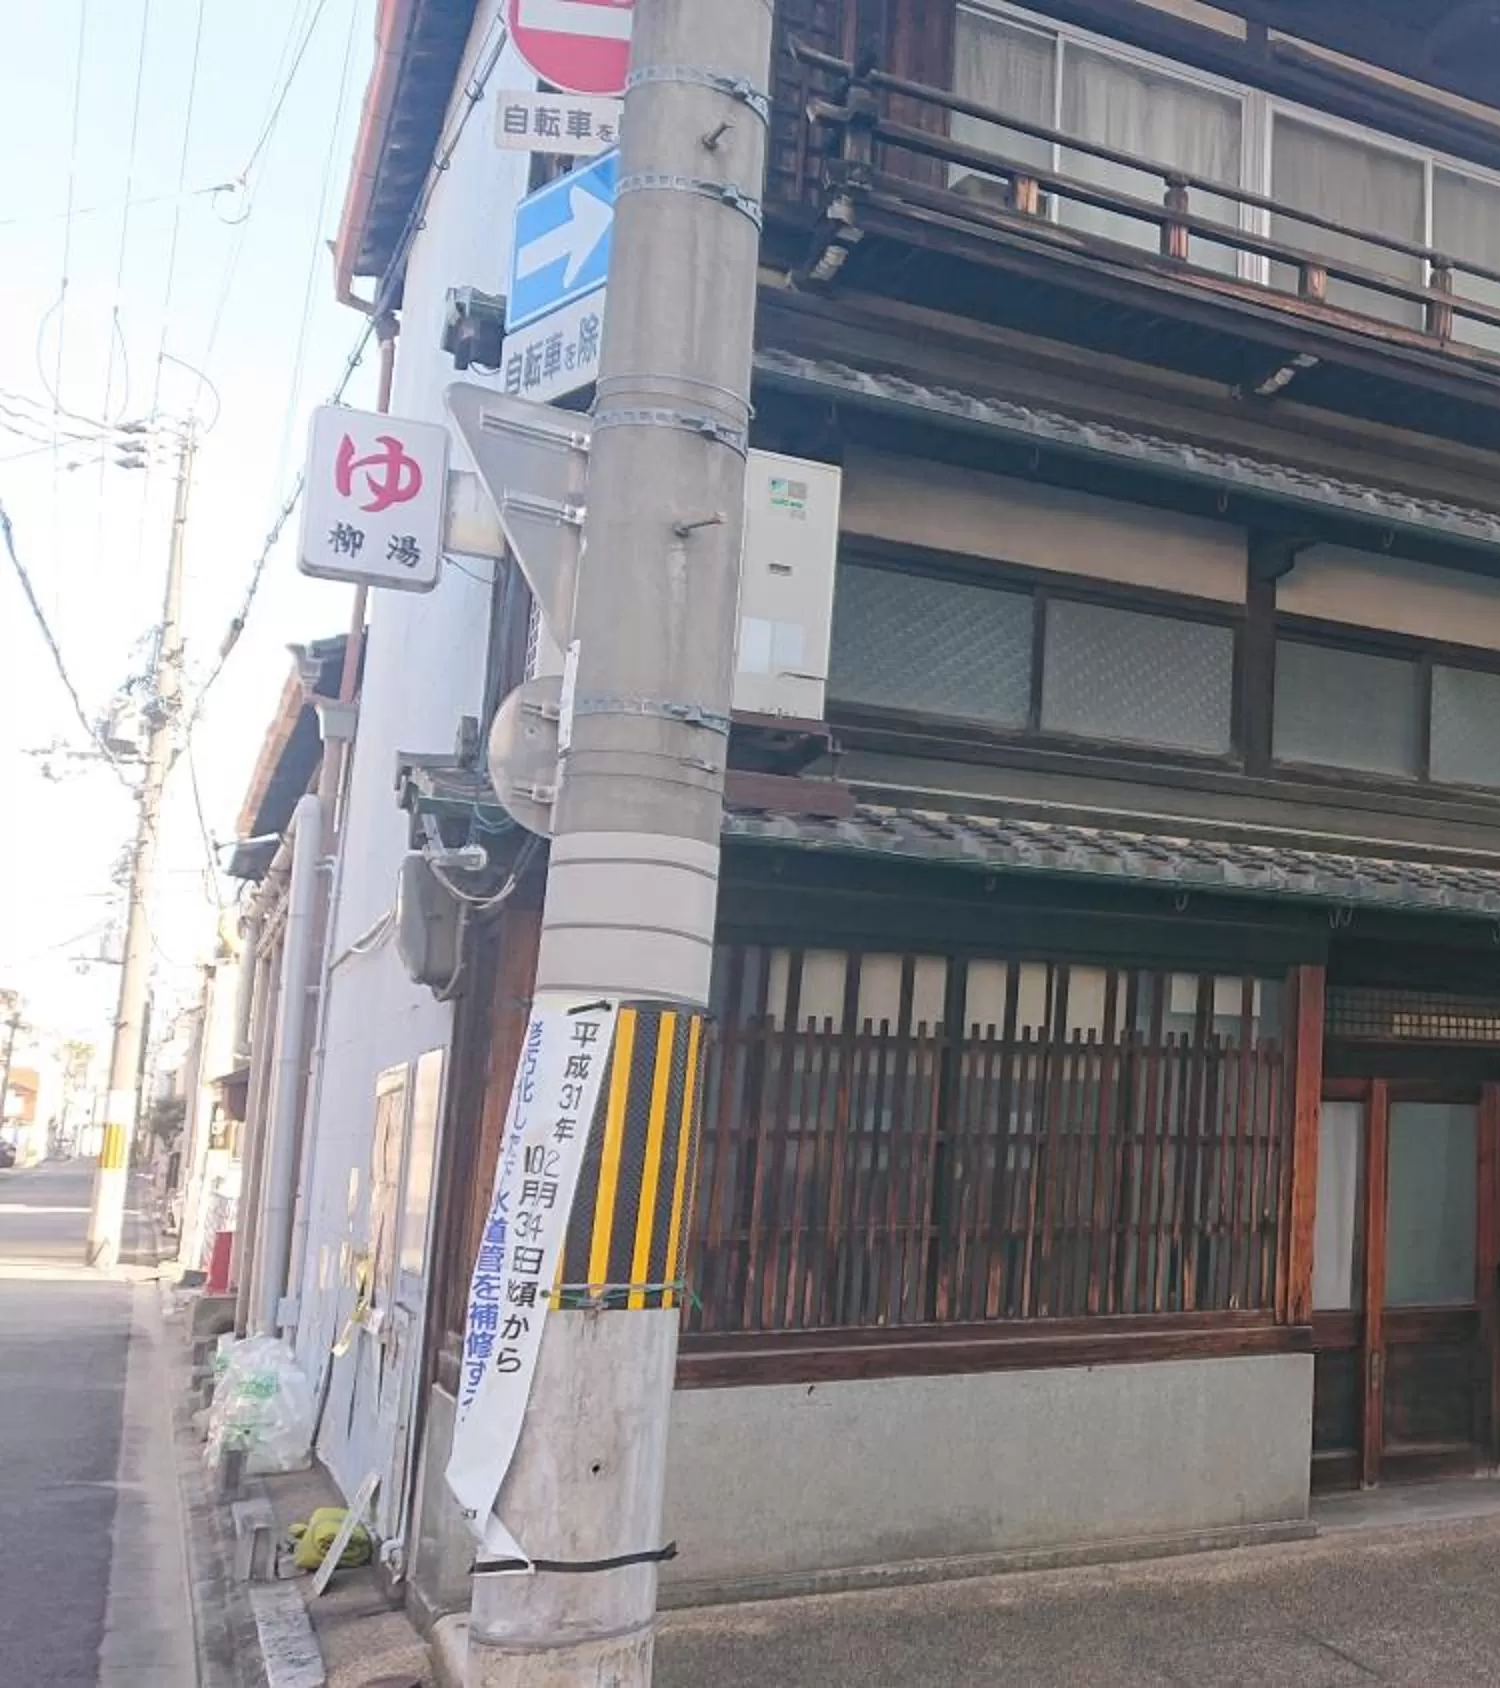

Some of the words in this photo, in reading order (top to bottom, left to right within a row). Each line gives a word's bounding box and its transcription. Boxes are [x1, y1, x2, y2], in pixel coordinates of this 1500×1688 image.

[503, 104, 624, 143] 自転車を
[335, 431, 423, 513] ゆ
[327, 519, 421, 568] 柳湯
